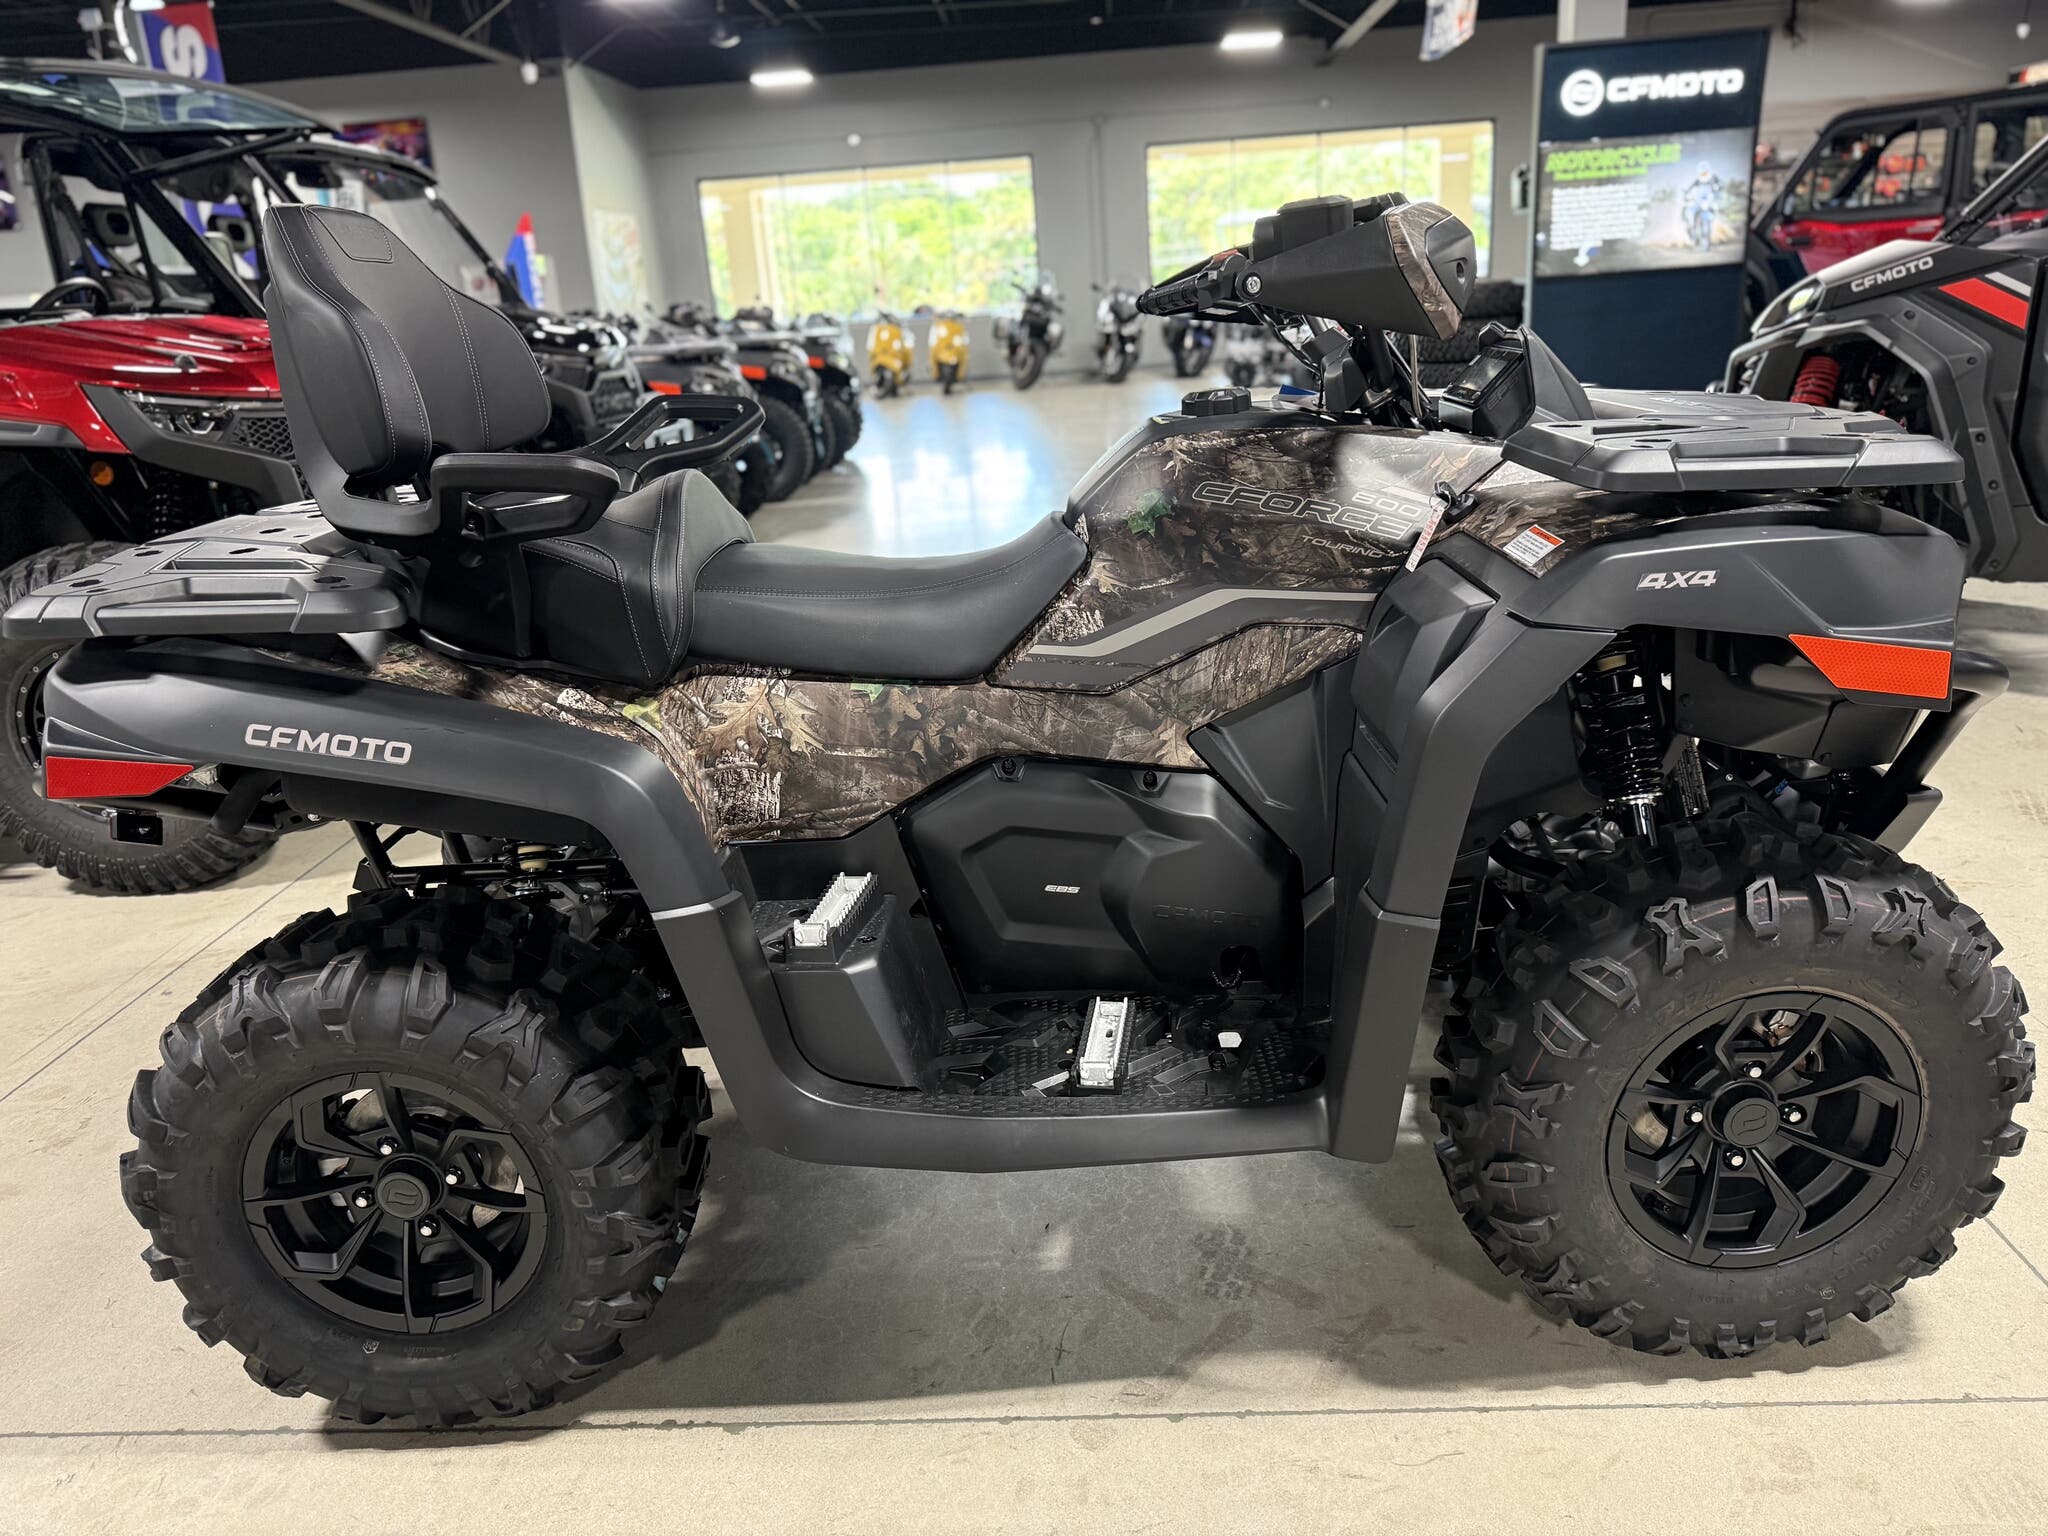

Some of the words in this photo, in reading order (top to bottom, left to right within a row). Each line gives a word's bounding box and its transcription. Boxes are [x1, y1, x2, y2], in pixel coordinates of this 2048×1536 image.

[1606, 68, 1745, 103] CFMOTO
[1850, 255, 1934, 293] CFMOTO
[1192, 481, 1416, 540] CFORCE
[1301, 535, 1385, 559] TOURING
[1637, 569, 1718, 590] 4X4
[244, 723, 412, 765] CFMOTO
[1044, 884, 1081, 894] EBS
